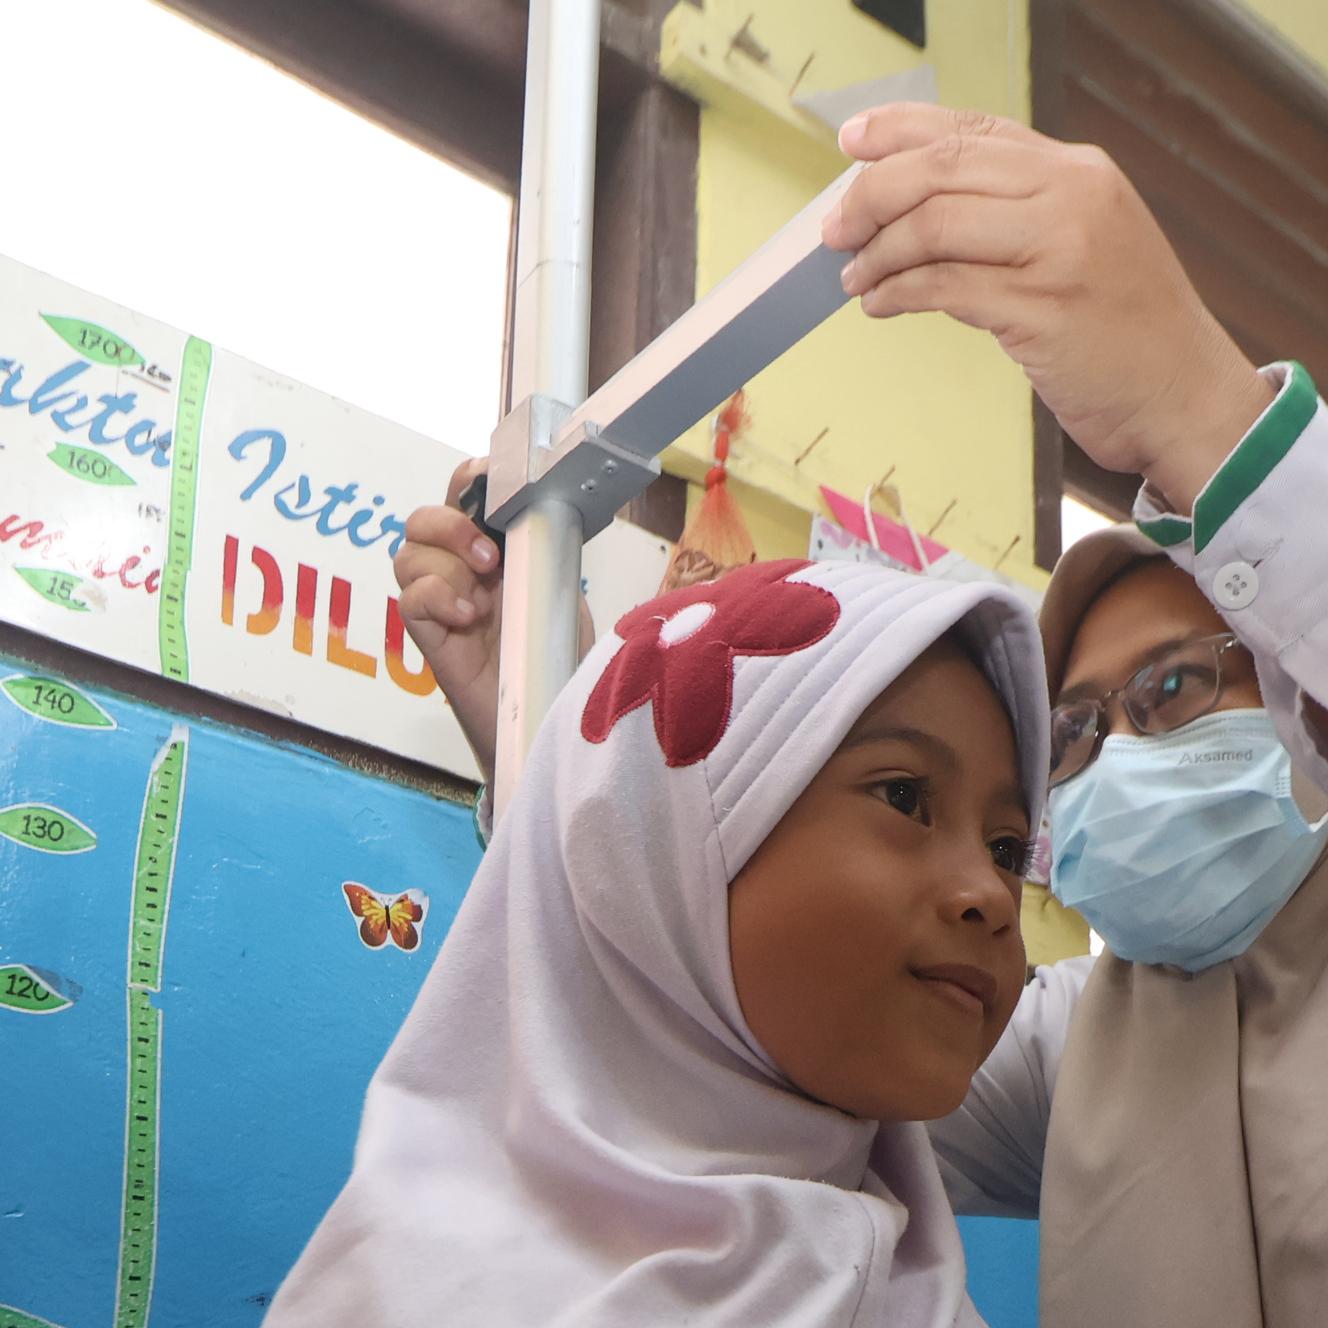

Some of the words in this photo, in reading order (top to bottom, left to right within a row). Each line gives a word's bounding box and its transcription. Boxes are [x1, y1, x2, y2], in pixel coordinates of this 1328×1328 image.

[227, 428, 407, 561] Istir
[46, 576, 87, 608] 15
[221, 533, 441, 698] DILU
[32, 684, 76, 715] 140
[1177, 748, 1253, 766] Aksamed
[21, 814, 65, 842] 130
